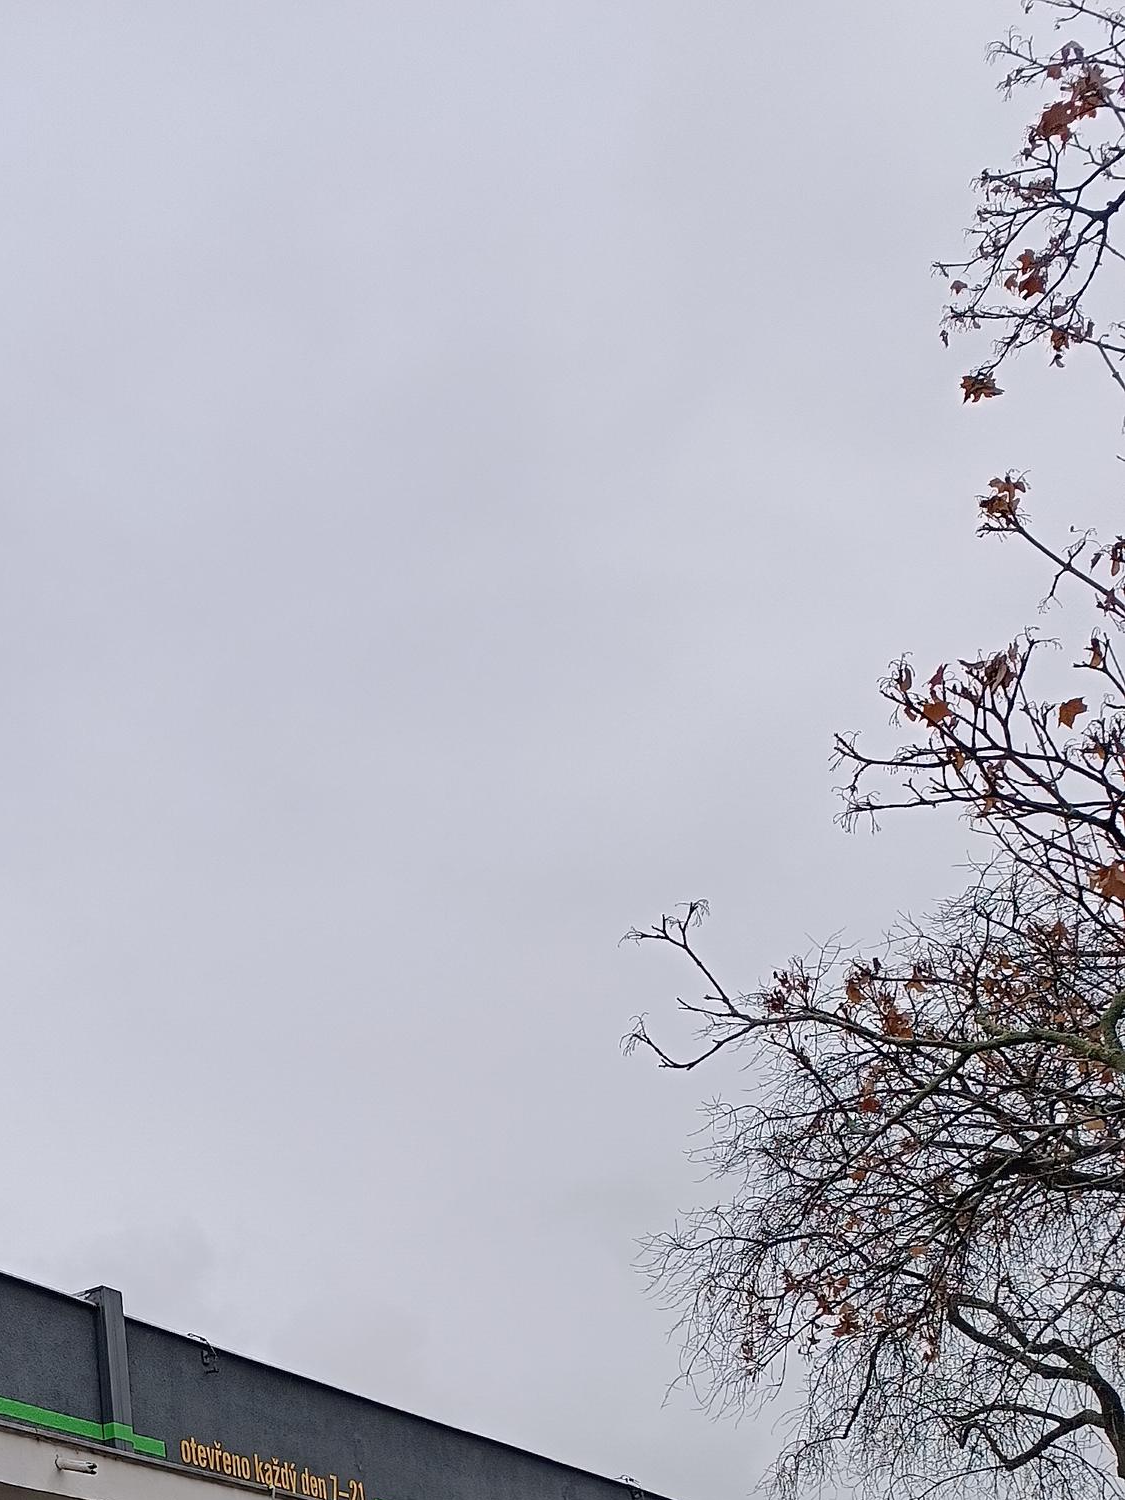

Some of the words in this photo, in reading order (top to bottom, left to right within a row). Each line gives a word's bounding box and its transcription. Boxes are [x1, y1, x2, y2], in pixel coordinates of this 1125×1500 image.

[180, 1437, 251, 1480] otevřeno
[253, 1454, 298, 1494] každý
[301, 1468, 327, 1500] den
